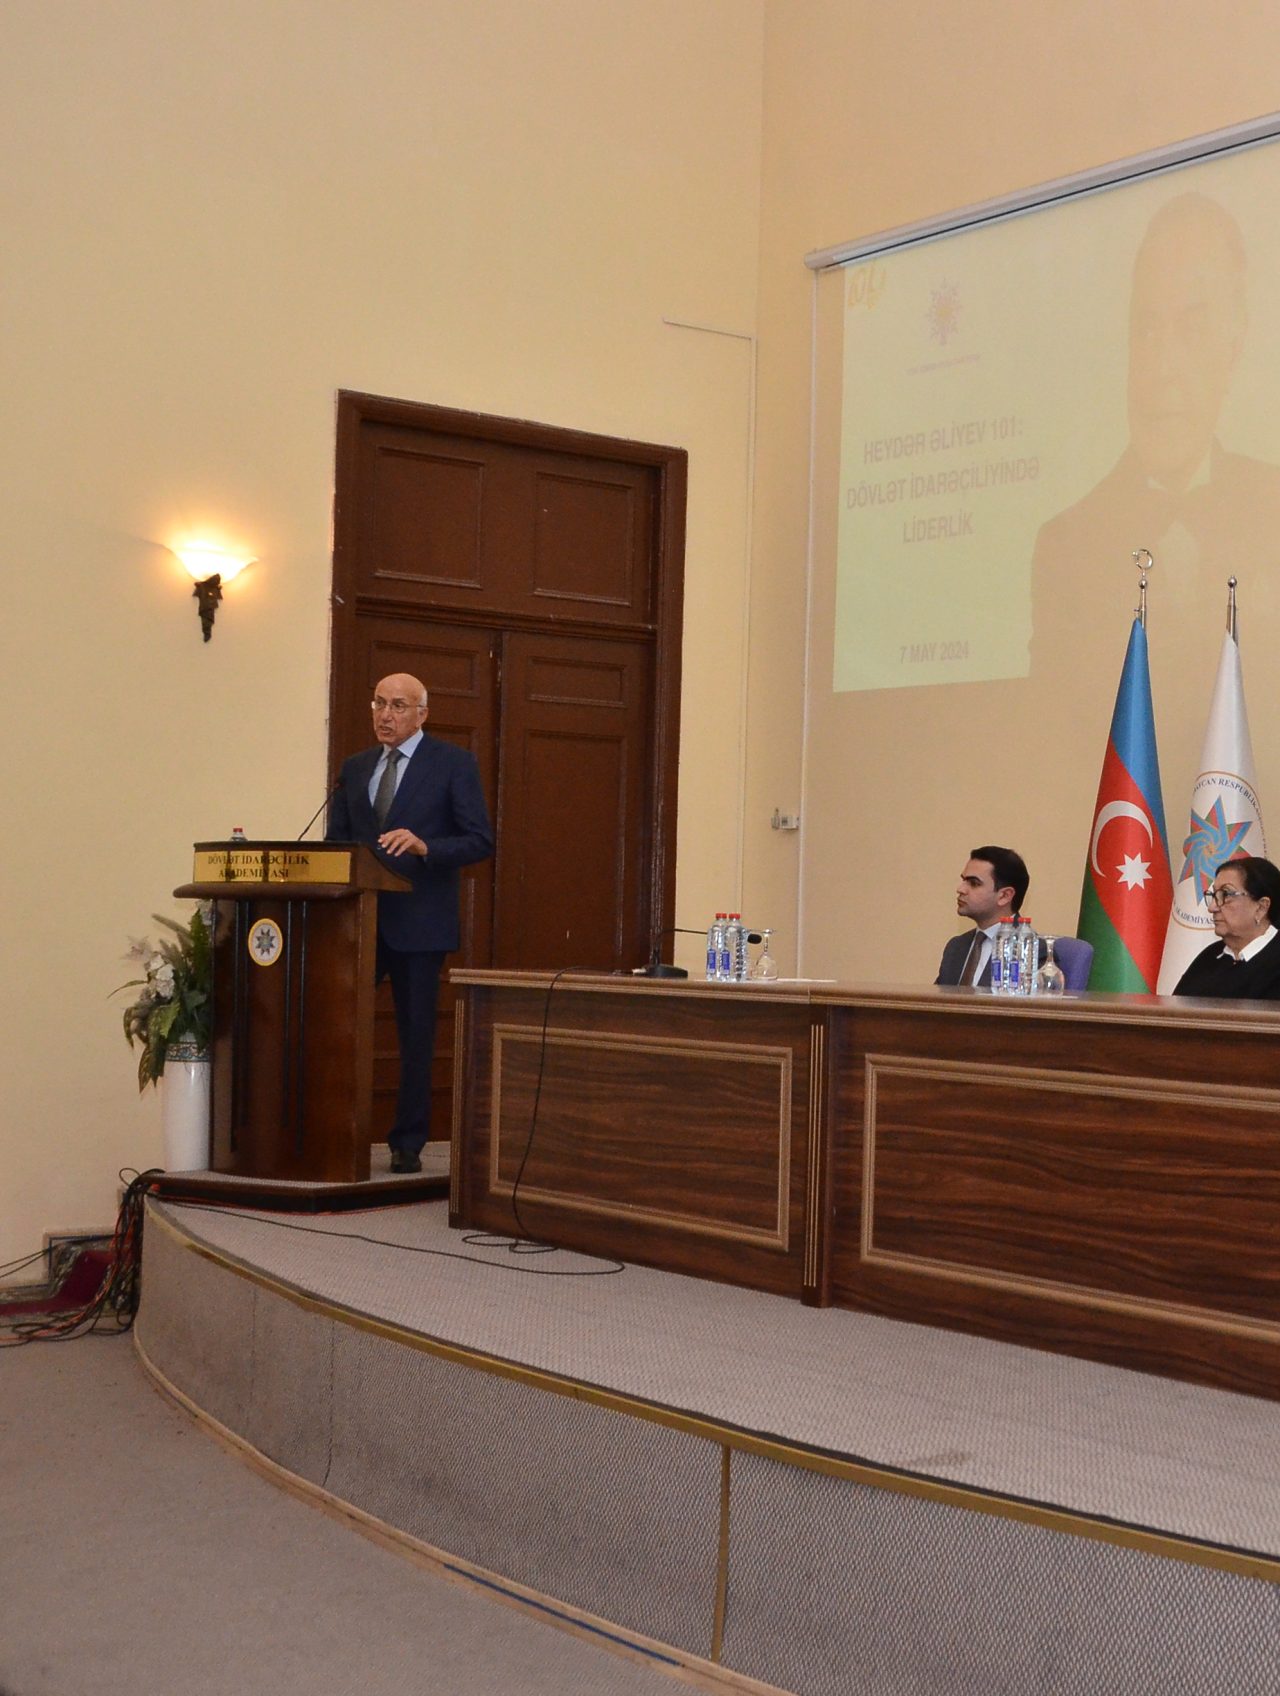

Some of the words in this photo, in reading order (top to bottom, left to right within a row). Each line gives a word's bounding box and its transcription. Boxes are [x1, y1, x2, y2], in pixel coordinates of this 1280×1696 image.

[863, 432, 926, 465] HEYDƏR
[929, 419, 987, 453] ƏLİYEV
[990, 415, 1024, 441] 101:
[846, 478, 907, 510] DÖVLƏT
[902, 508, 975, 544] LİDERLİK
[900, 646, 908, 665] 7
[909, 643, 937, 664] MAY
